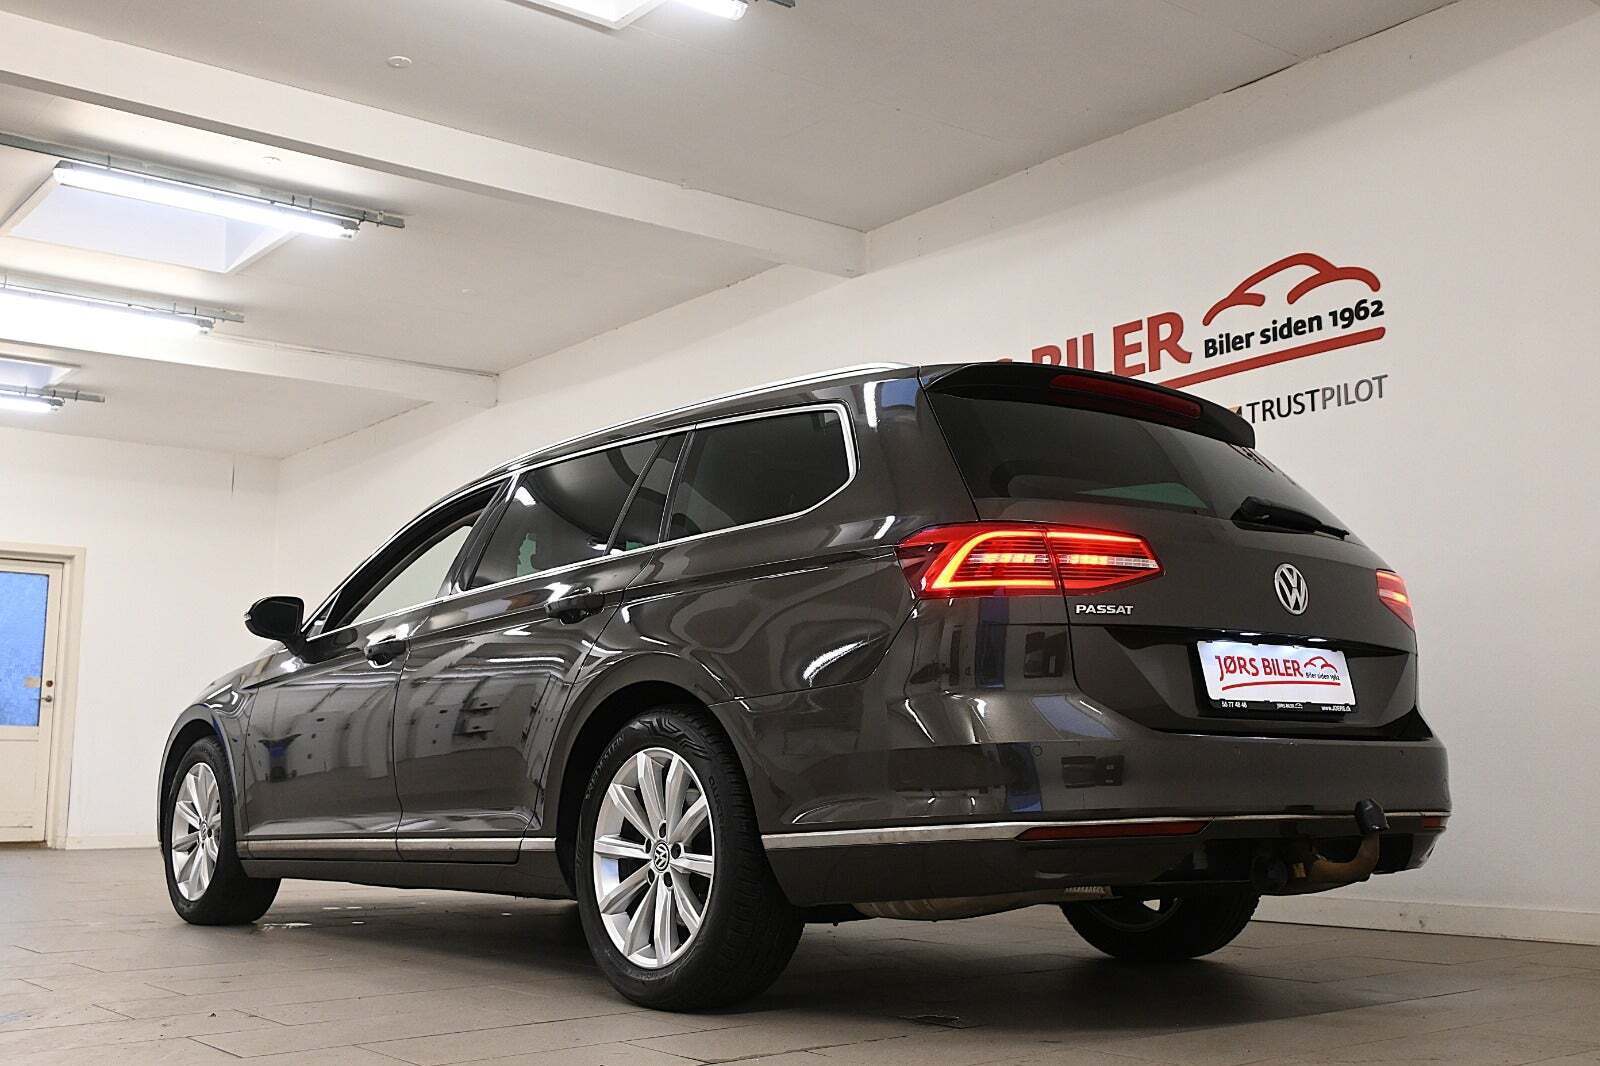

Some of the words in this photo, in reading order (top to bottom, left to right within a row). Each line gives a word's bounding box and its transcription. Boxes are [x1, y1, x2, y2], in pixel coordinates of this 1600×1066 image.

[1203, 331, 1254, 358] Biler
[1259, 313, 1322, 345] siden
[1328, 298, 1385, 329] 1962
[1246, 374, 1389, 424] TRUSTPILOT
[1075, 604, 1134, 615] PASSAT
[1215, 655, 1260, 682] JØRS
[1262, 657, 1303, 678] BILER
